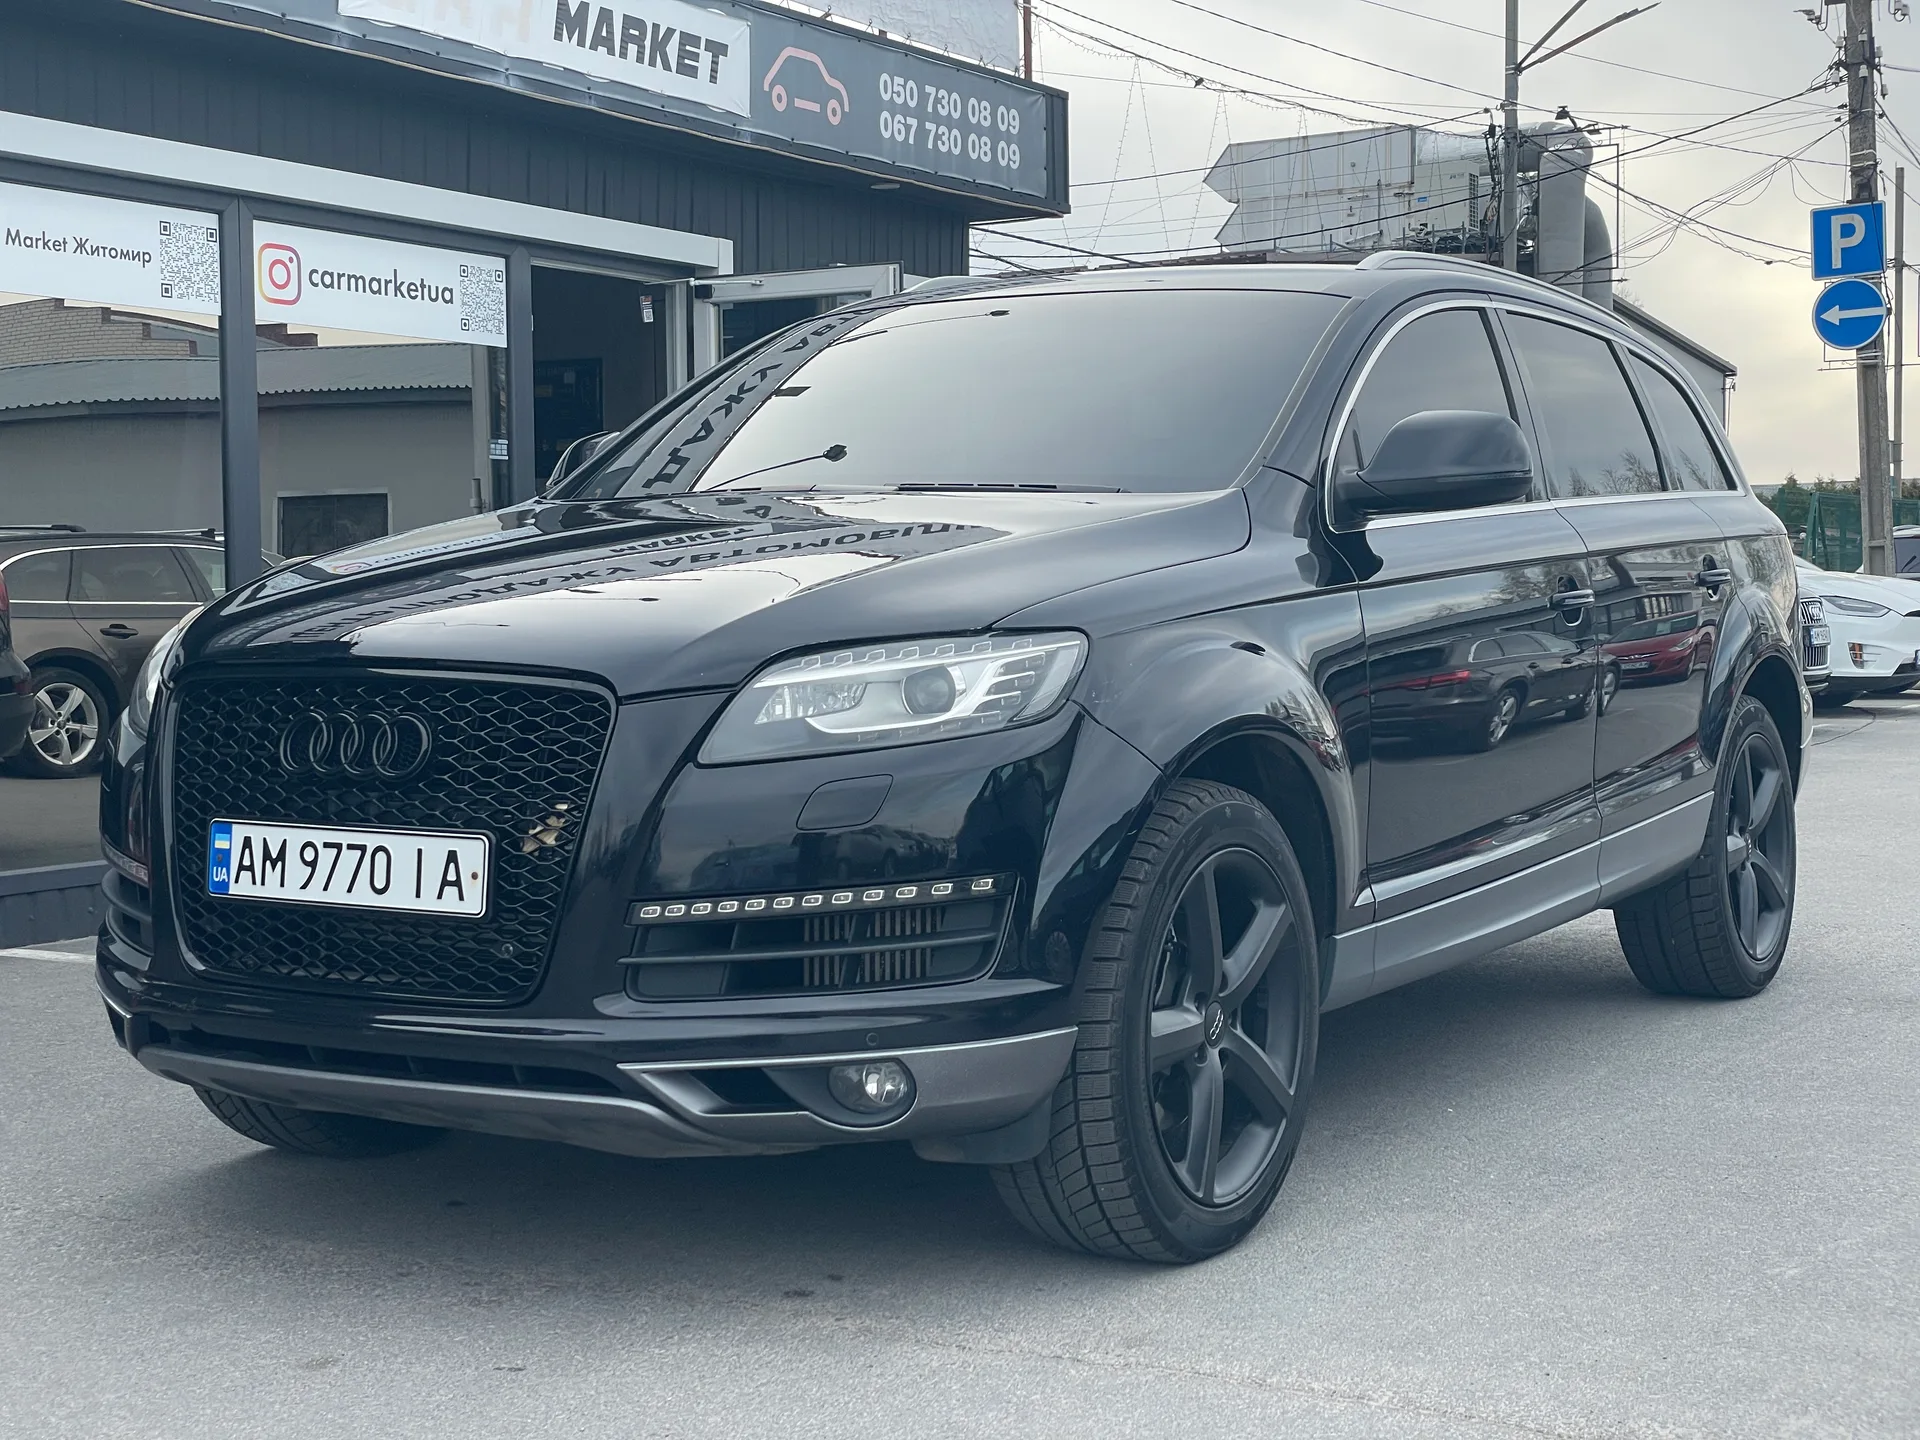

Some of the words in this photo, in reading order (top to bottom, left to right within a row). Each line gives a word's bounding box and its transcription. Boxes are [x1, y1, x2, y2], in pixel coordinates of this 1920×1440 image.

[553, 0, 728, 84] MARKET
[879, 72, 918, 108] 050
[925, 85, 962, 119] 730
[967, 97, 991, 127] 08
[997, 105, 1020, 135] 09
[879, 110, 918, 145] 067
[925, 121, 962, 155] 730
[967, 132, 992, 162] 08
[997, 140, 1020, 169] 09
[5, 227, 68, 253] Market
[72, 236, 152, 268] Житомир
[1830, 213, 1866, 270] P
[308, 268, 454, 305] carmarketua
[213, 867, 229, 882] UA
[234, 836, 287, 888] AM
[299, 840, 392, 895] 9770
[415, 848, 465, 901] IA
